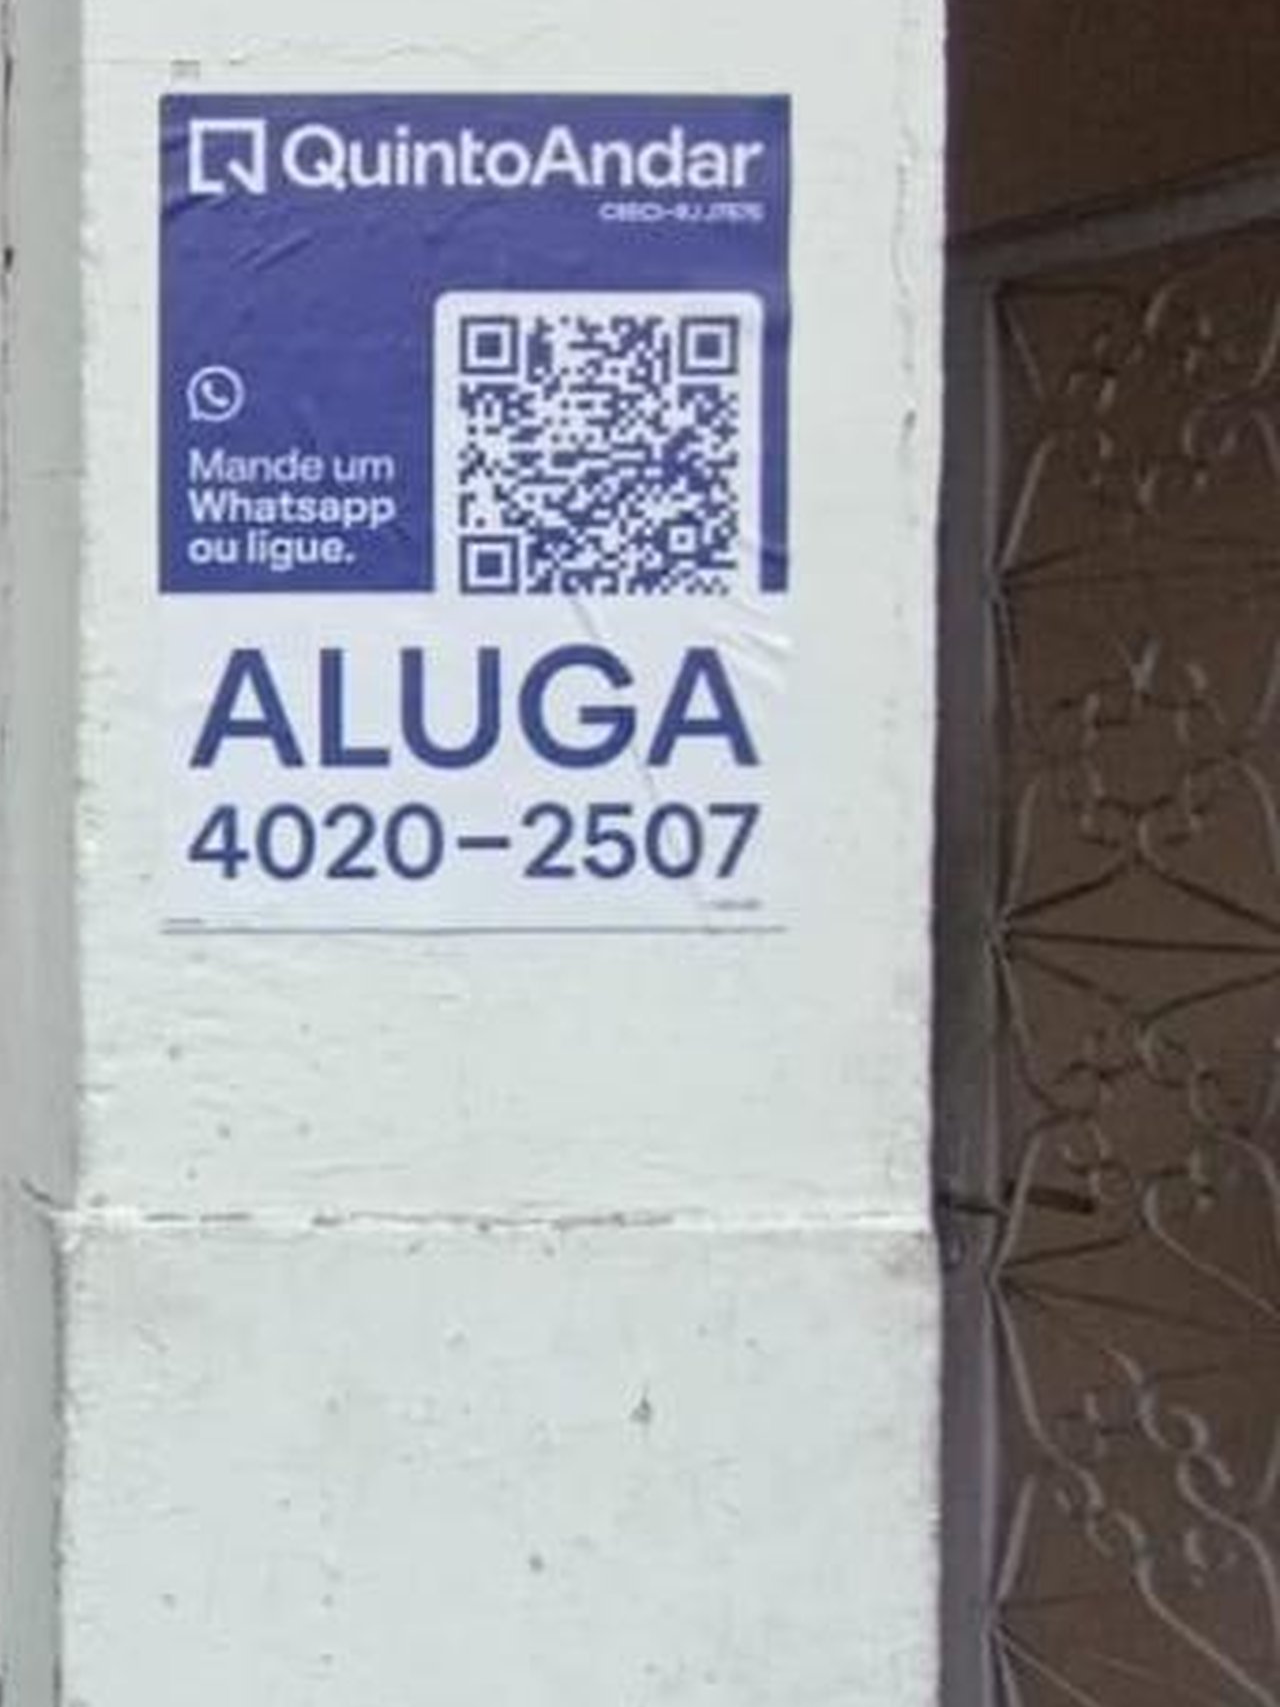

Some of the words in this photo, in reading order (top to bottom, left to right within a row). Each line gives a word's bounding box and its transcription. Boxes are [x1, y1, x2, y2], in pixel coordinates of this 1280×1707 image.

[281, 123, 766, 191] QuintoAndar
[188, 448, 323, 483] Mande
[333, 455, 394, 483] um
[187, 488, 396, 530] Whatsapp
[188, 537, 239, 564] ou
[246, 528, 356, 571] ligue.
[188, 643, 761, 770] ALUGA
[187, 802, 762, 881] 4020-2507
